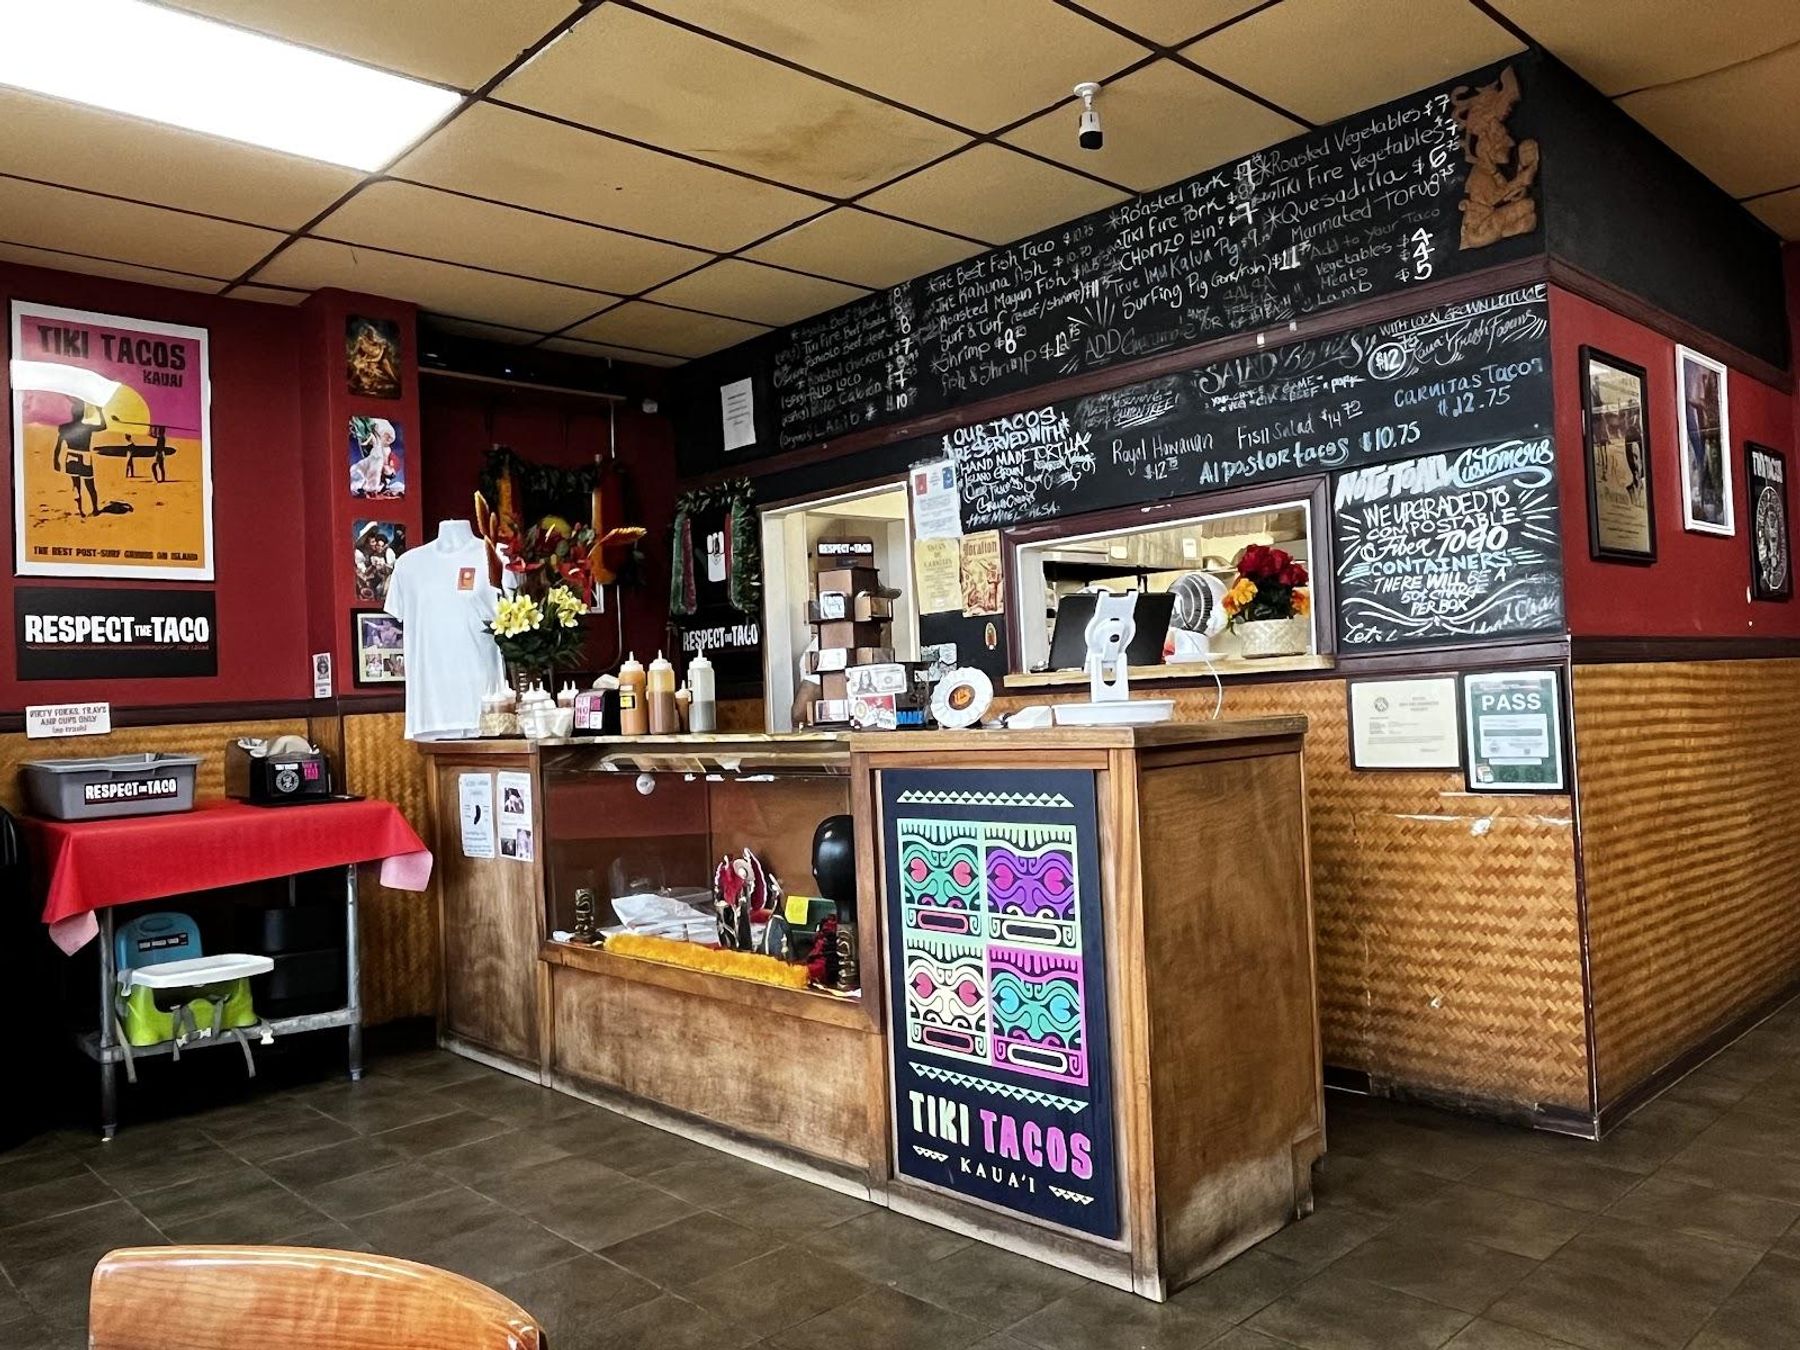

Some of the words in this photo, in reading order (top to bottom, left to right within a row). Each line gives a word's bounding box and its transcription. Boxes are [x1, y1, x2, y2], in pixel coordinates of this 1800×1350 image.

[1273, 138, 1330, 173] Roasted
[1335, 108, 1421, 154] Vegetables
[1307, 165, 1345, 189] Fire
[1350, 125, 1445, 175] Vegetables
[1120, 188, 1184, 225] Roasted
[1188, 171, 1231, 199] Pork
[1181, 197, 1227, 224] Pork
[1281, 168, 1408, 225] Quesadilla
[1292, 198, 1373, 243] Marinated
[1373, 181, 1428, 211] TOFU
[1402, 208, 1441, 226] Taco
[989, 250, 1019, 273] Fish
[1019, 239, 1056, 261] Taco
[1315, 243, 1394, 276] Vegetables
[1112, 277, 1141, 299] True
[1170, 248, 1214, 279] Kalua
[1184, 271, 1209, 299] Pig
[939, 299, 989, 332] Roasted
[994, 286, 1033, 313] Mayan
[1034, 270, 1072, 295] Fish
[958, 276, 1012, 305] Kahuna
[1378, 321, 1409, 338] WITH
[37, 325, 89, 360] TIKI
[101, 333, 187, 371] TACOS
[935, 341, 991, 373] Shrimp
[143, 370, 184, 389] KAUAI
[979, 349, 1037, 386] Shrimp
[953, 424, 988, 447] OUR
[989, 405, 1059, 437] TACOS
[1027, 420, 1068, 445] WITH
[959, 457, 995, 477] HAND
[996, 447, 1032, 468] MADE
[1334, 468, 1390, 512] NOTE
[1362, 503, 1393, 529] WE
[1392, 490, 1489, 524] UPGRADED
[1485, 485, 1511, 509] TO
[1365, 506, 1521, 541] COMPOSTABLE
[51, 547, 73, 557] BEST
[1371, 549, 1514, 577] CONTAINERS
[1372, 575, 1424, 596] THERE
[1426, 572, 1461, 591] WILL
[1410, 601, 1438, 617] PER
[1438, 598, 1471, 614] BOX
[24, 614, 136, 644] RESPECT
[150, 616, 210, 644] TACO
[682, 626, 726, 652] RESPECT
[731, 623, 759, 647] TACO
[1481, 693, 1543, 712] PASS
[84, 781, 141, 800] RESPECT
[146, 778, 178, 796] TACO
[908, 1090, 970, 1147] TIKI
[979, 1108, 1094, 1180] TACOS
[959, 1156, 1036, 1194] KAUA'I
